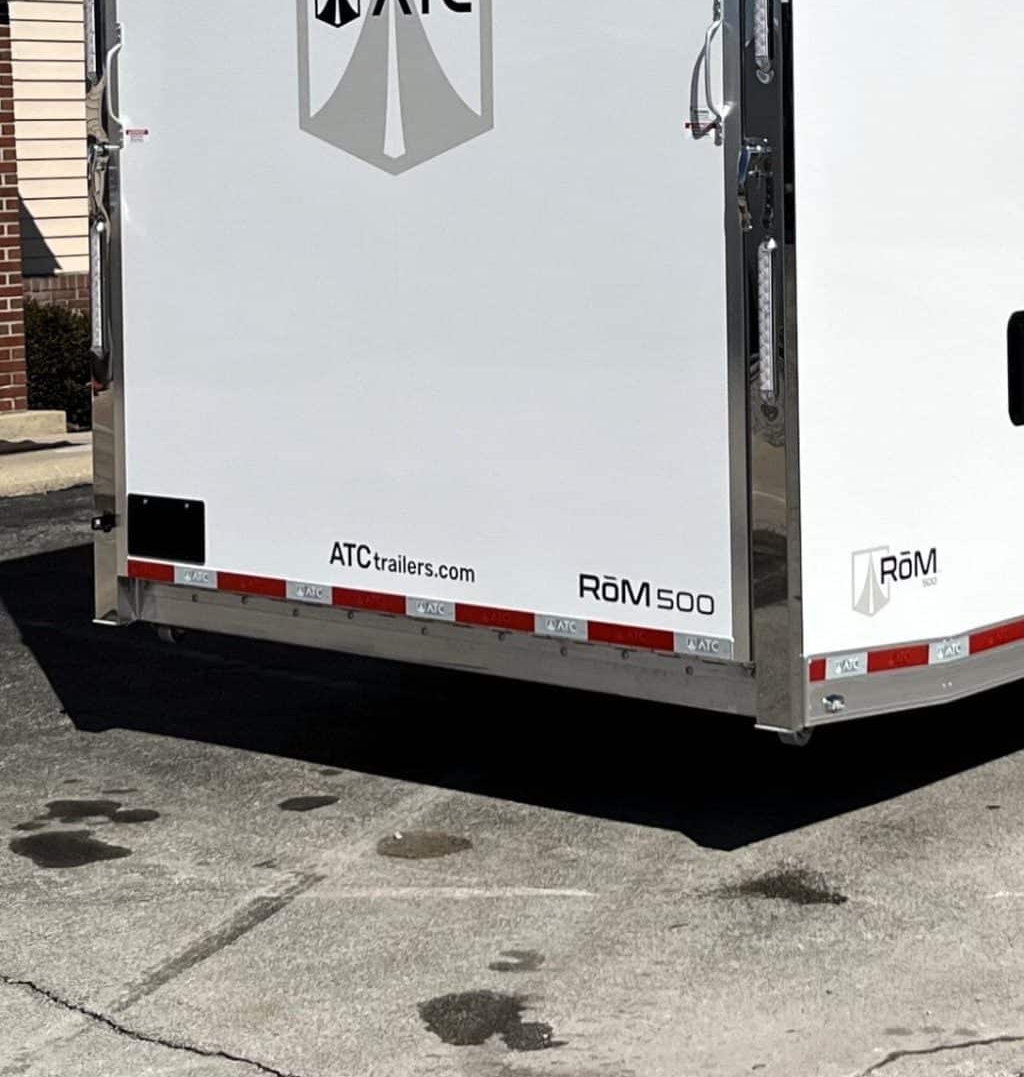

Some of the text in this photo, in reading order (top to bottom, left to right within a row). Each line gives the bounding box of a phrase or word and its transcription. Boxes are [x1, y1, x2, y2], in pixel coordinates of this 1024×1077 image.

[329, 541, 475, 583] ATCtrailers.com
[305, 586, 323, 598] ATC
[656, 588, 715, 616] 500
[426, 603, 445, 616] ATC
[556, 621, 577, 633] ATC
[698, 639, 721, 652] ATC
